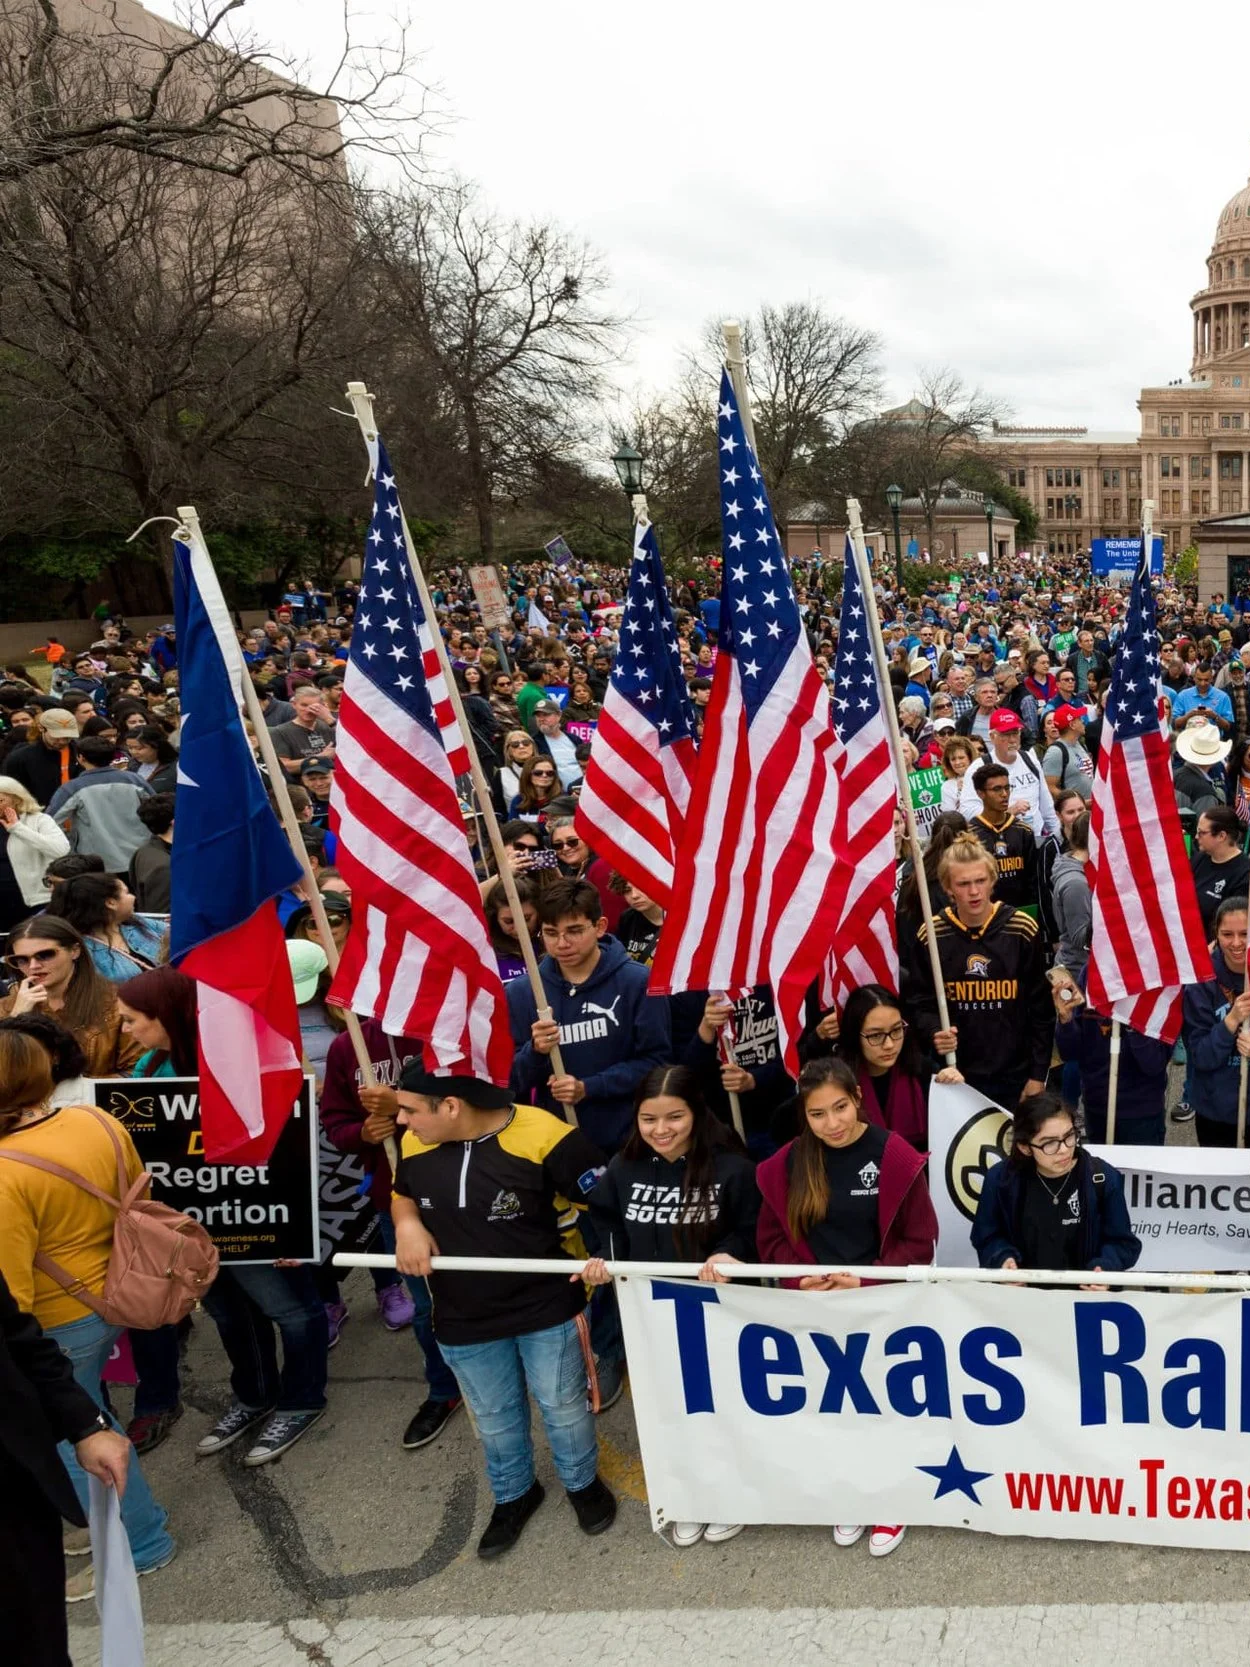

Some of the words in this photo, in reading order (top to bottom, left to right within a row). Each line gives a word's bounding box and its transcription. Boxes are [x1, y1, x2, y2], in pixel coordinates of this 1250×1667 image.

[1105, 541, 1142, 549] REMEMB
[908, 774, 923, 790] VE
[923, 768, 945, 788] LIFE
[1016, 773, 1037, 786] VE
[958, 1002, 1003, 1010] SOCCER
[558, 1017, 609, 1045] UMA
[145, 1160, 270, 1193] Regret
[182, 1199, 290, 1226] ortion
[1166, 1219, 1219, 1238] Hearts,
[651, 1280, 1026, 1427] Texas
